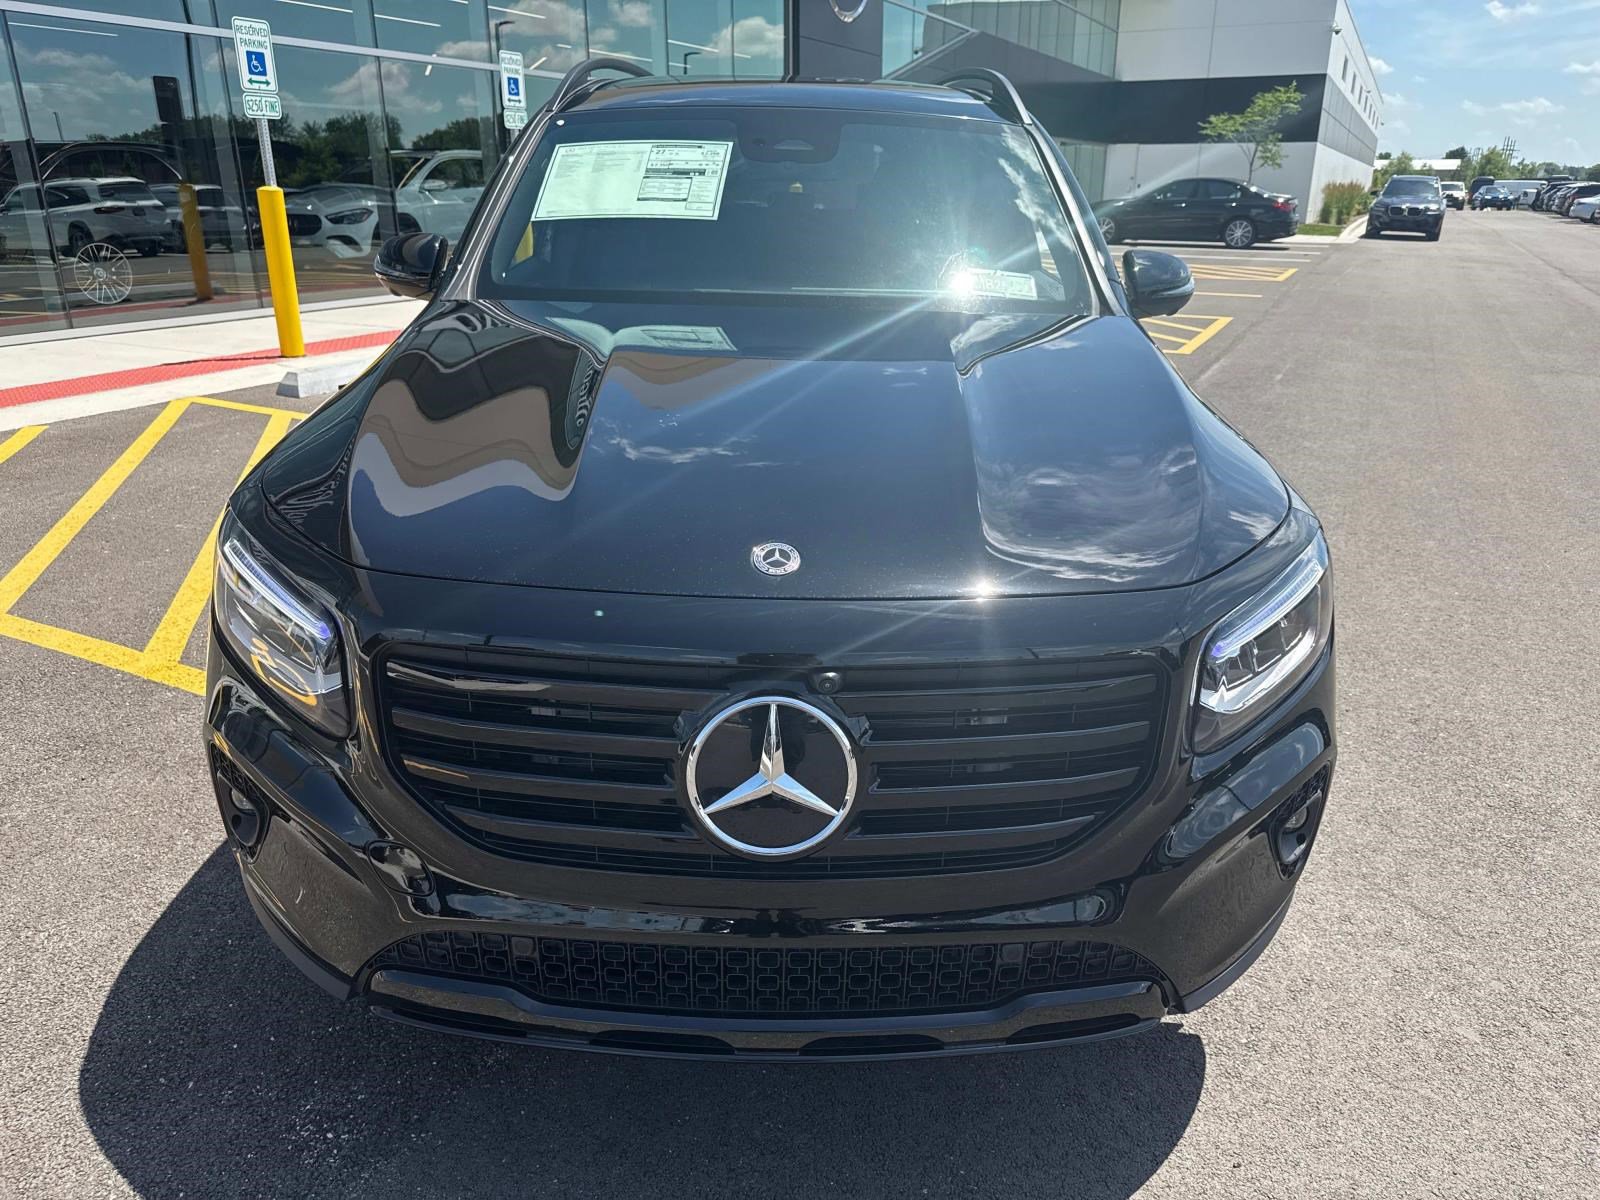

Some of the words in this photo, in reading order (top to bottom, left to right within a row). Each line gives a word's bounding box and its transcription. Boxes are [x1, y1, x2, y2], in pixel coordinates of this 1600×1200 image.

[235, 24, 268, 38] RESERVED
[239, 37, 268, 50] PARKING
[246, 98, 263, 113] $250
[264, 100, 279, 114] FINE
